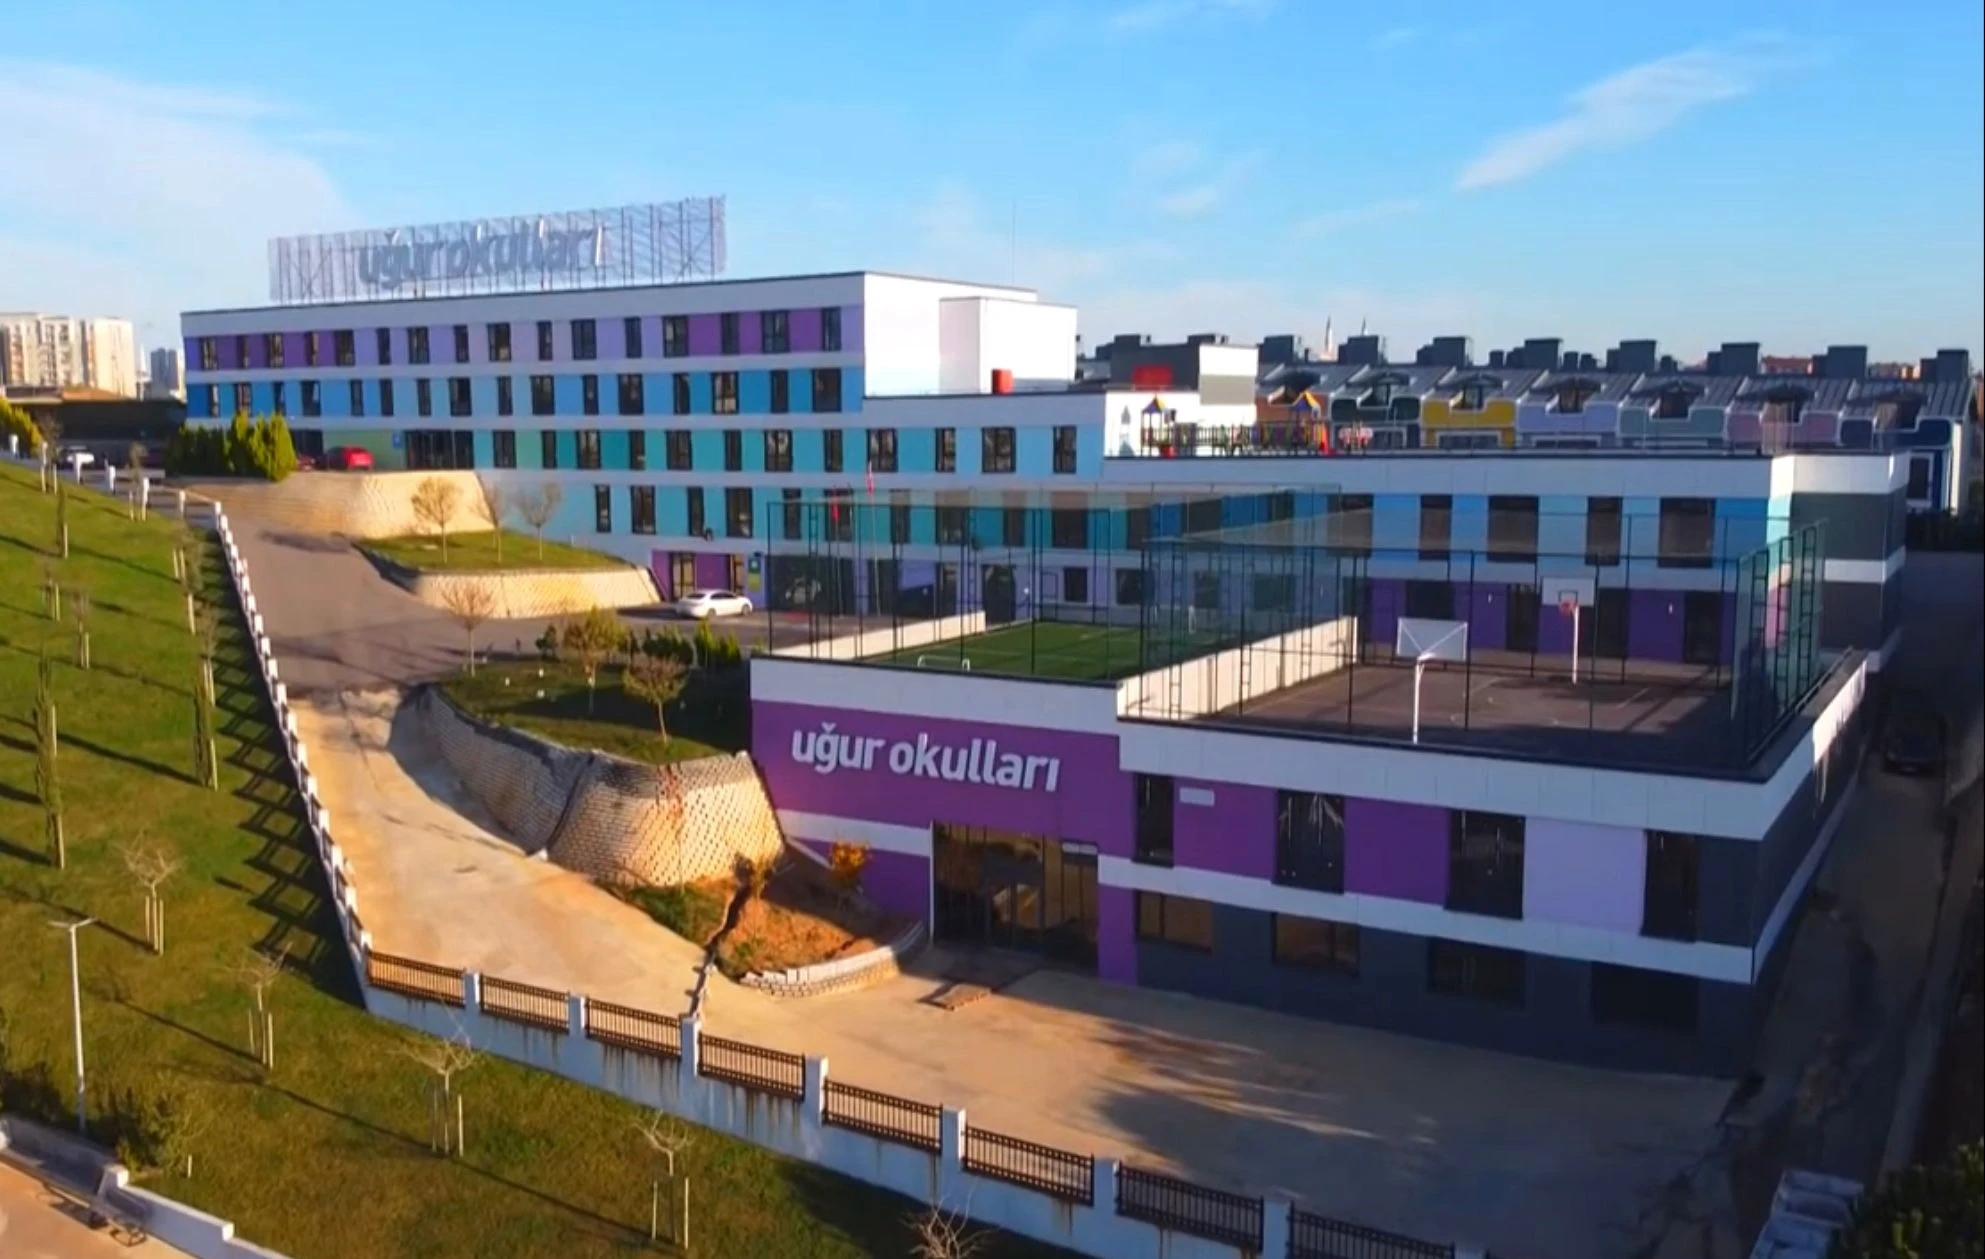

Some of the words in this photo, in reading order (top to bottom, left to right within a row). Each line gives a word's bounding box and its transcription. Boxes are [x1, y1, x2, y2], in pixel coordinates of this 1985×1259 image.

[359, 228, 445, 290] uğur
[792, 721, 885, 774] uğur
[889, 733, 1060, 792] okulları
